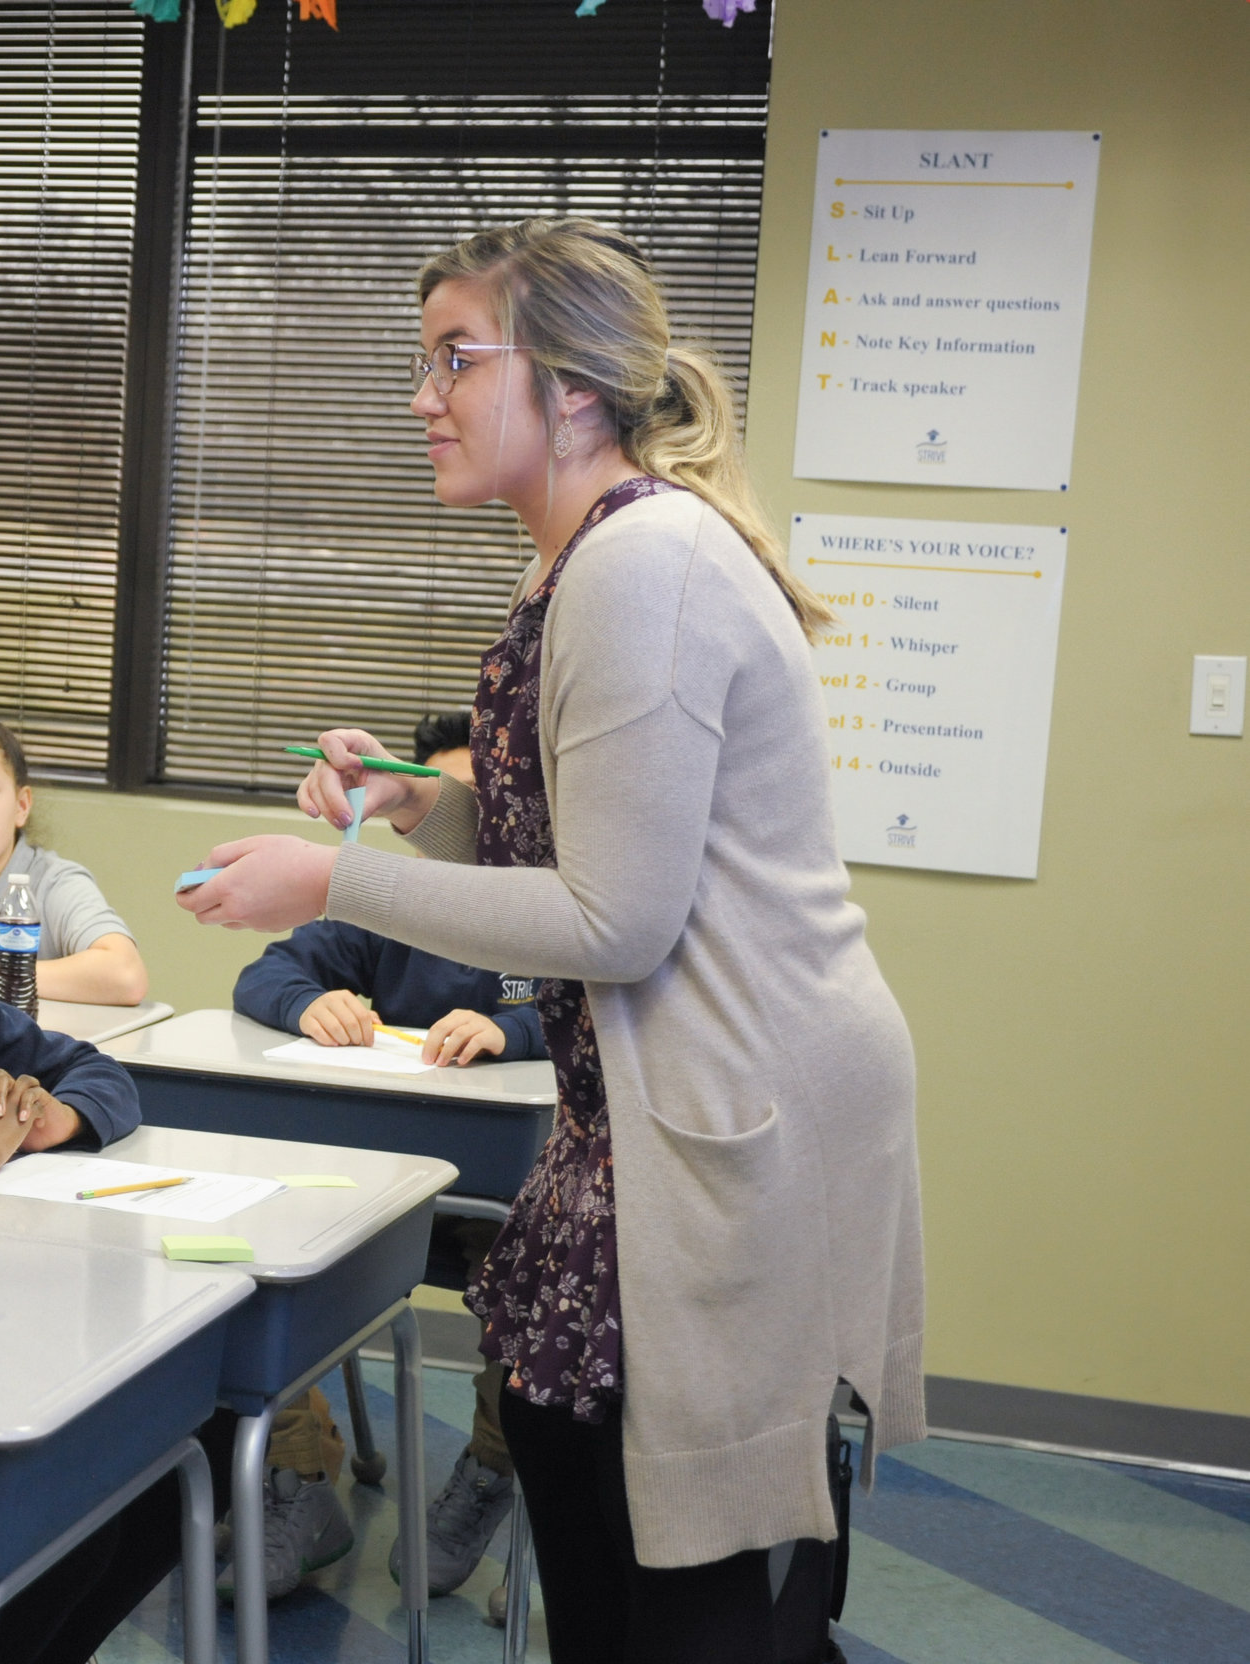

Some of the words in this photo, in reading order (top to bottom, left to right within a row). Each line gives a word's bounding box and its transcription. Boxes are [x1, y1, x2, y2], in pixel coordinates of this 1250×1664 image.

[918, 151, 994, 170] SLANT
[829, 200, 846, 220] S
[863, 204, 886, 220] Sit
[891, 204, 915, 224] Up
[826, 244, 841, 263] L
[859, 247, 900, 263] Lean
[905, 248, 977, 266] Forward
[823, 287, 839, 305] A
[858, 292, 887, 307] Ask
[891, 293, 921, 308] and
[925, 297, 982, 309] answer
[985, 296, 1061, 314] questions
[820, 330, 837, 348] N
[856, 333, 893, 350] Note
[898, 335, 929, 355] Key
[935, 336, 1036, 355] Information
[816, 373, 832, 391] T
[849, 377, 898, 393] Track
[902, 380, 967, 398] speaker
[820, 535, 904, 553] WHERE'S
[909, 540, 961, 557] YOUR
[966, 543, 1035, 561] VOICE?
[862, 591, 876, 608] 0
[893, 595, 939, 612] Silent
[822, 632, 853, 648] vel
[859, 633, 869, 649] 1
[890, 636, 959, 657] Whisper
[819, 673, 850, 689] vel
[855, 673, 868, 690] 2
[885, 678, 937, 699] Group
[851, 715, 864, 731] 3
[883, 718, 984, 740] Presentation
[847, 756, 860, 771] 4
[878, 759, 942, 778] Outside
